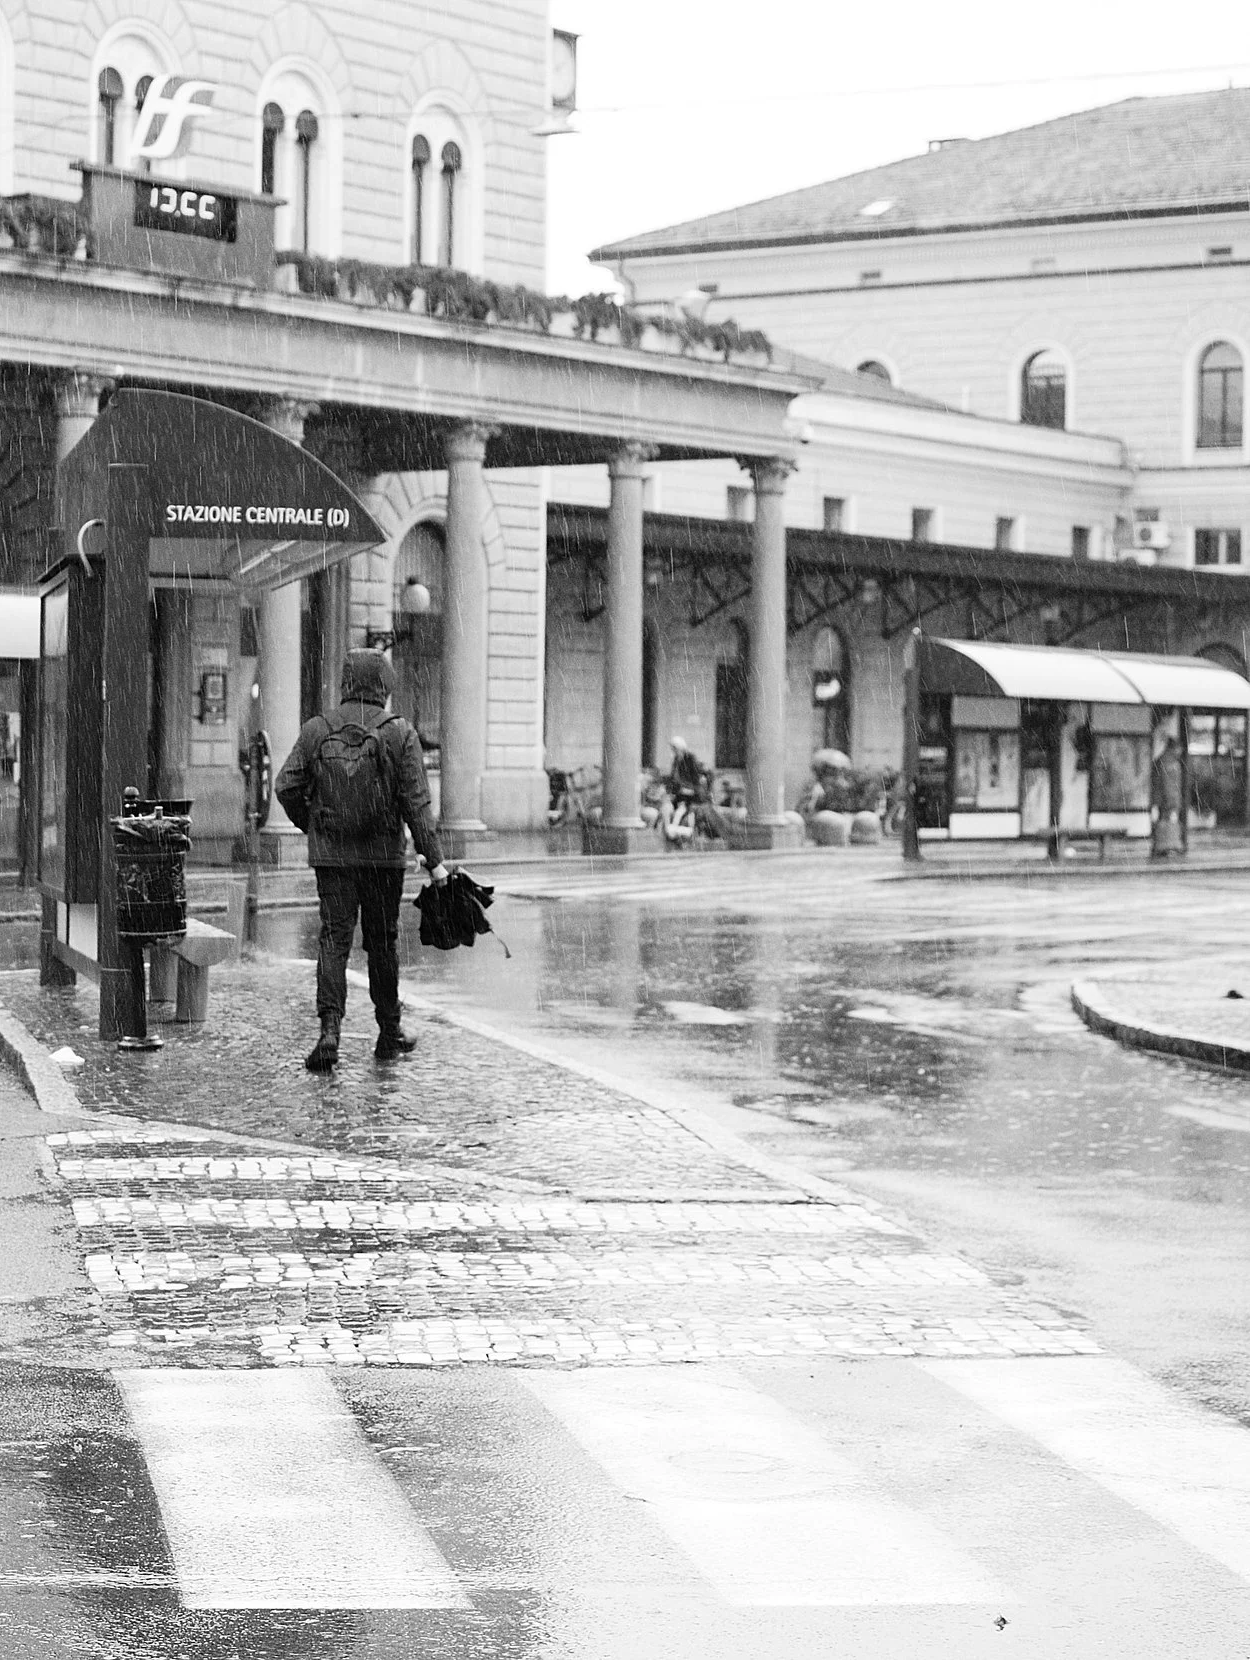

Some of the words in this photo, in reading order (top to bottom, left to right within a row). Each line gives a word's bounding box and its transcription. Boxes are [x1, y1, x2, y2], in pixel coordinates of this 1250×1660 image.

[166, 504, 242, 523] STAZIONE
[245, 506, 323, 525] CENTRALE
[327, 507, 350, 529] (D)
